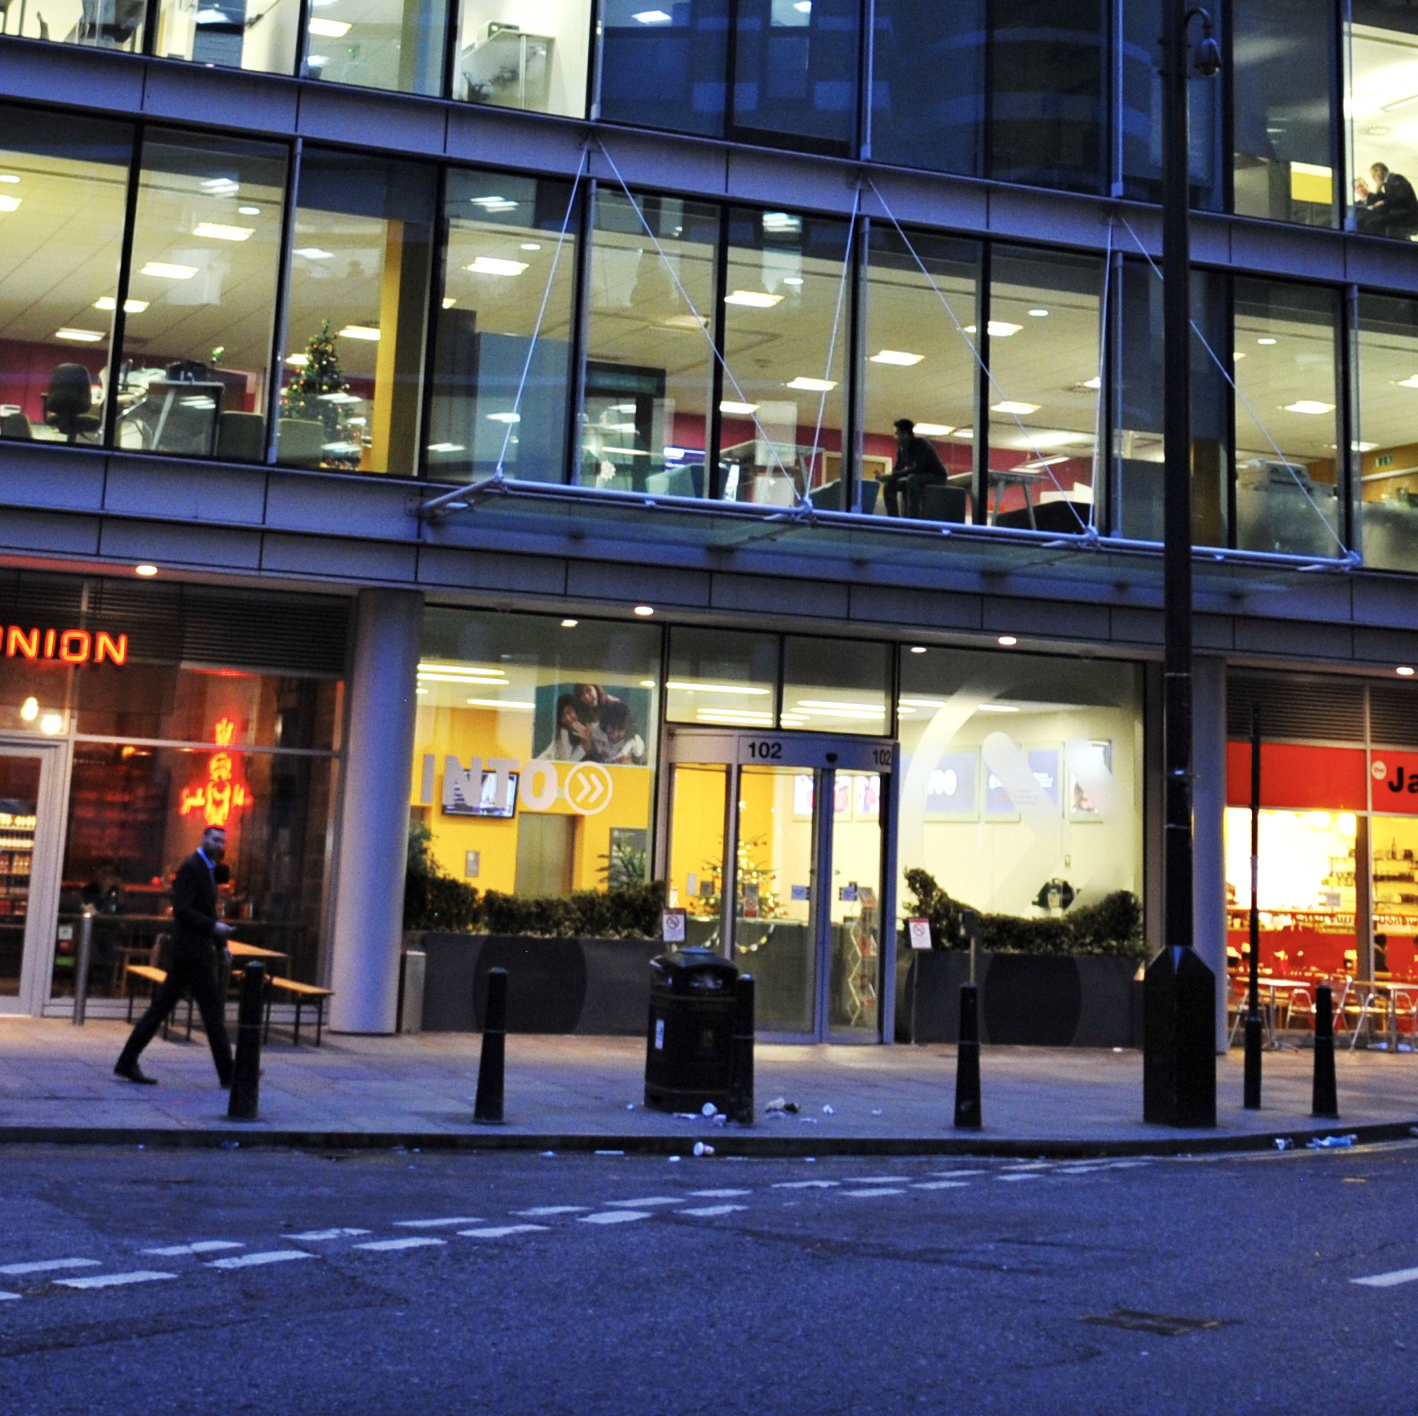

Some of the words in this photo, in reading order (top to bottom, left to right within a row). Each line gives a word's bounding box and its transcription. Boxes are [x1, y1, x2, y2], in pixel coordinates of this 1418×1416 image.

[748, 741, 782, 760] 102
[873, 748, 891, 766] 102
[420, 752, 559, 812] INTO
